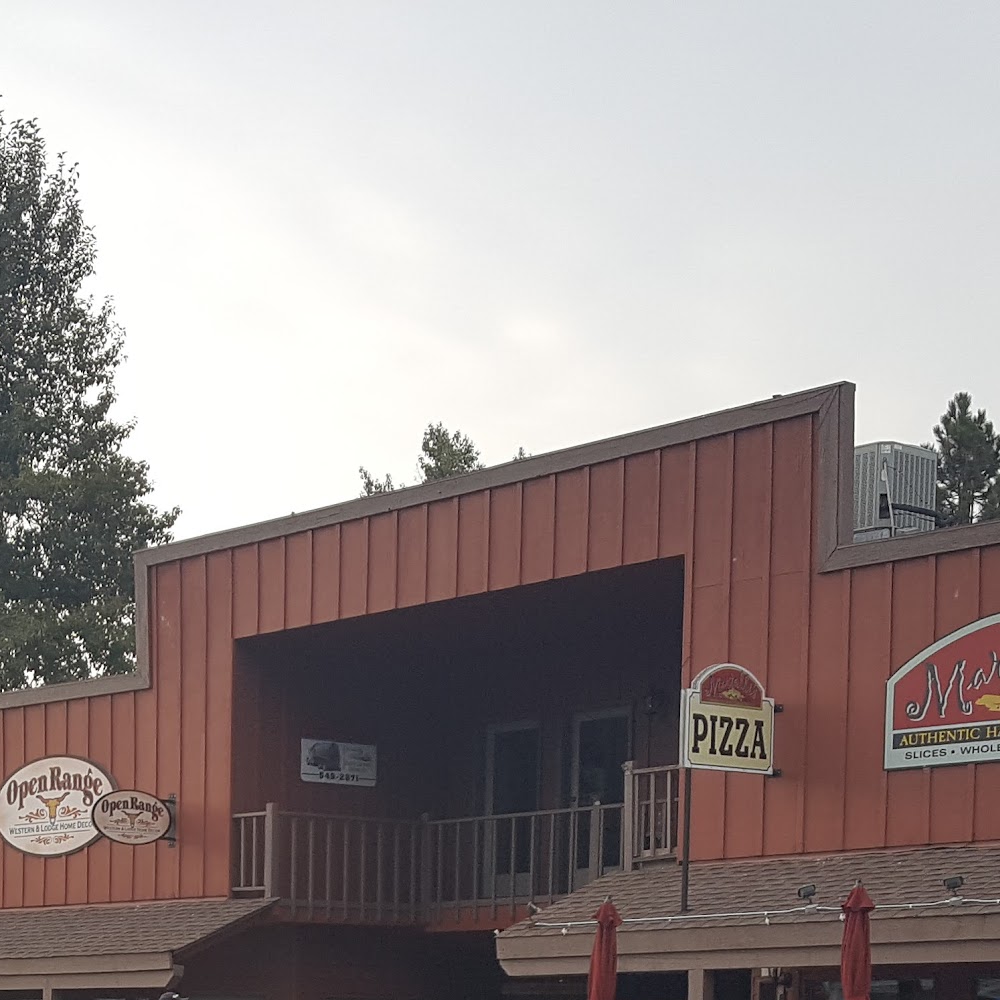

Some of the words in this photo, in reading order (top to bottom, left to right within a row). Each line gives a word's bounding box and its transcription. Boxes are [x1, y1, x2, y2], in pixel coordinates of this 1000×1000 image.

[692, 713, 766, 760] PIZZA
[900, 727, 980, 746] AUTHENTIC
[905, 748, 947, 760] SLICES
[9, 827, 35, 835] WESTERN
[41, 823, 59, 832] LODGE
[59, 822, 77, 831] HOME
